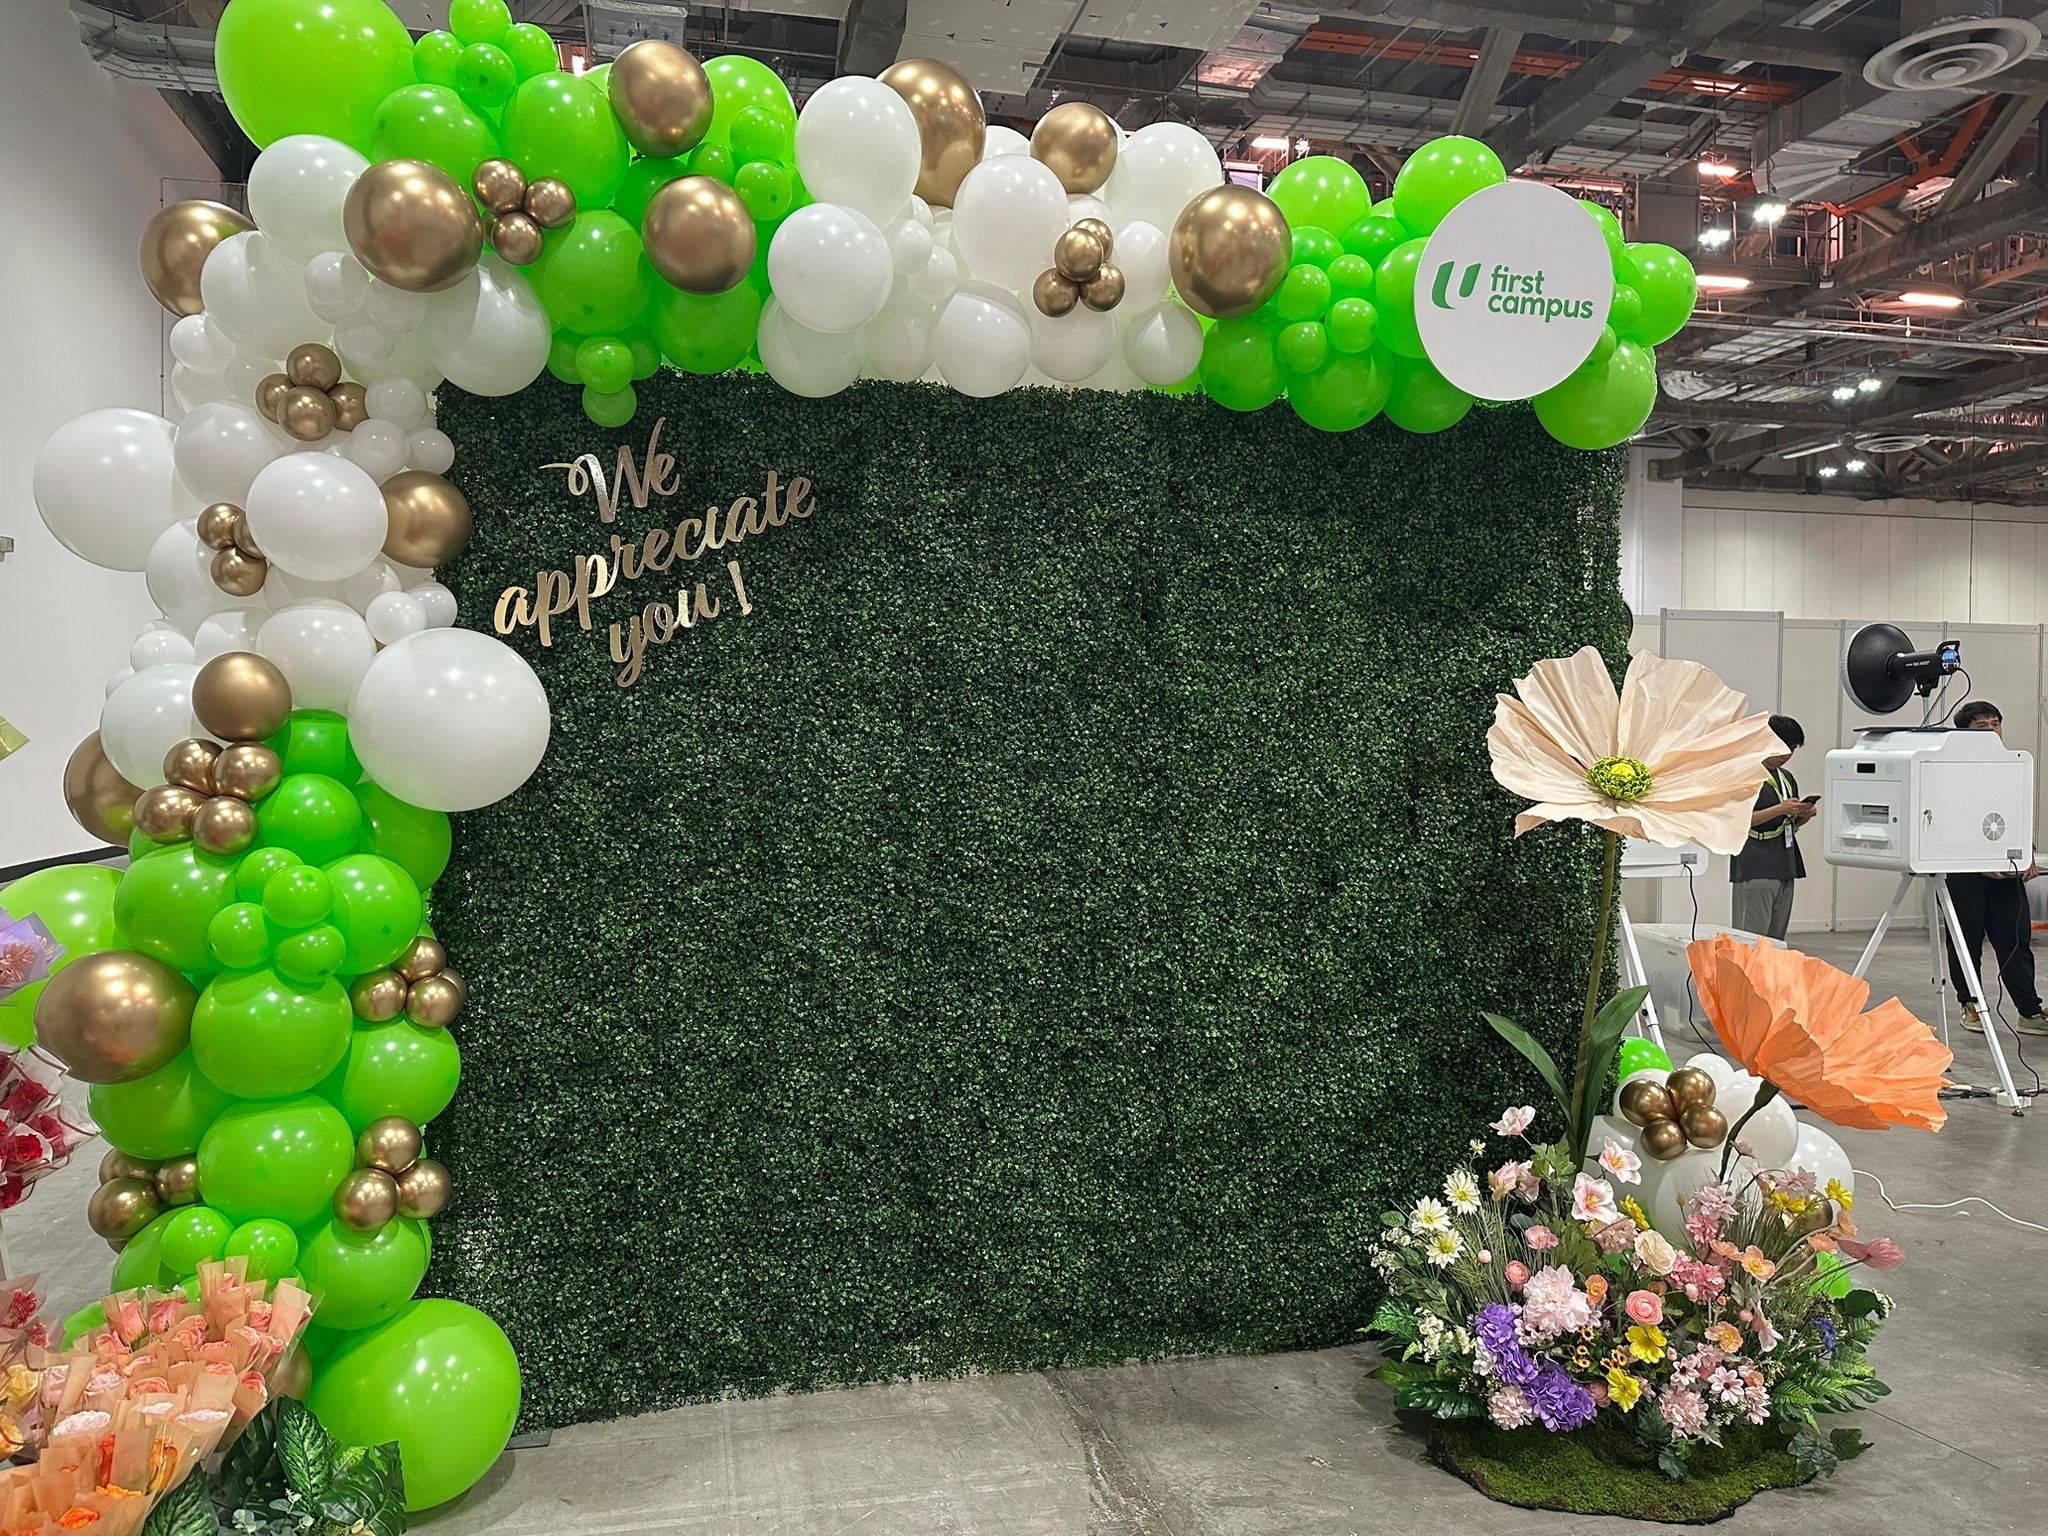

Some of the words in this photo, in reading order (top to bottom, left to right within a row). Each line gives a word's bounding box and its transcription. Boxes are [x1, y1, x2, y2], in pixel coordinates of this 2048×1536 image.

[1487, 294, 1594, 323] campus
[1490, 264, 1545, 295] first
[539, 416, 681, 524] We
[493, 470, 816, 647] appreciate
